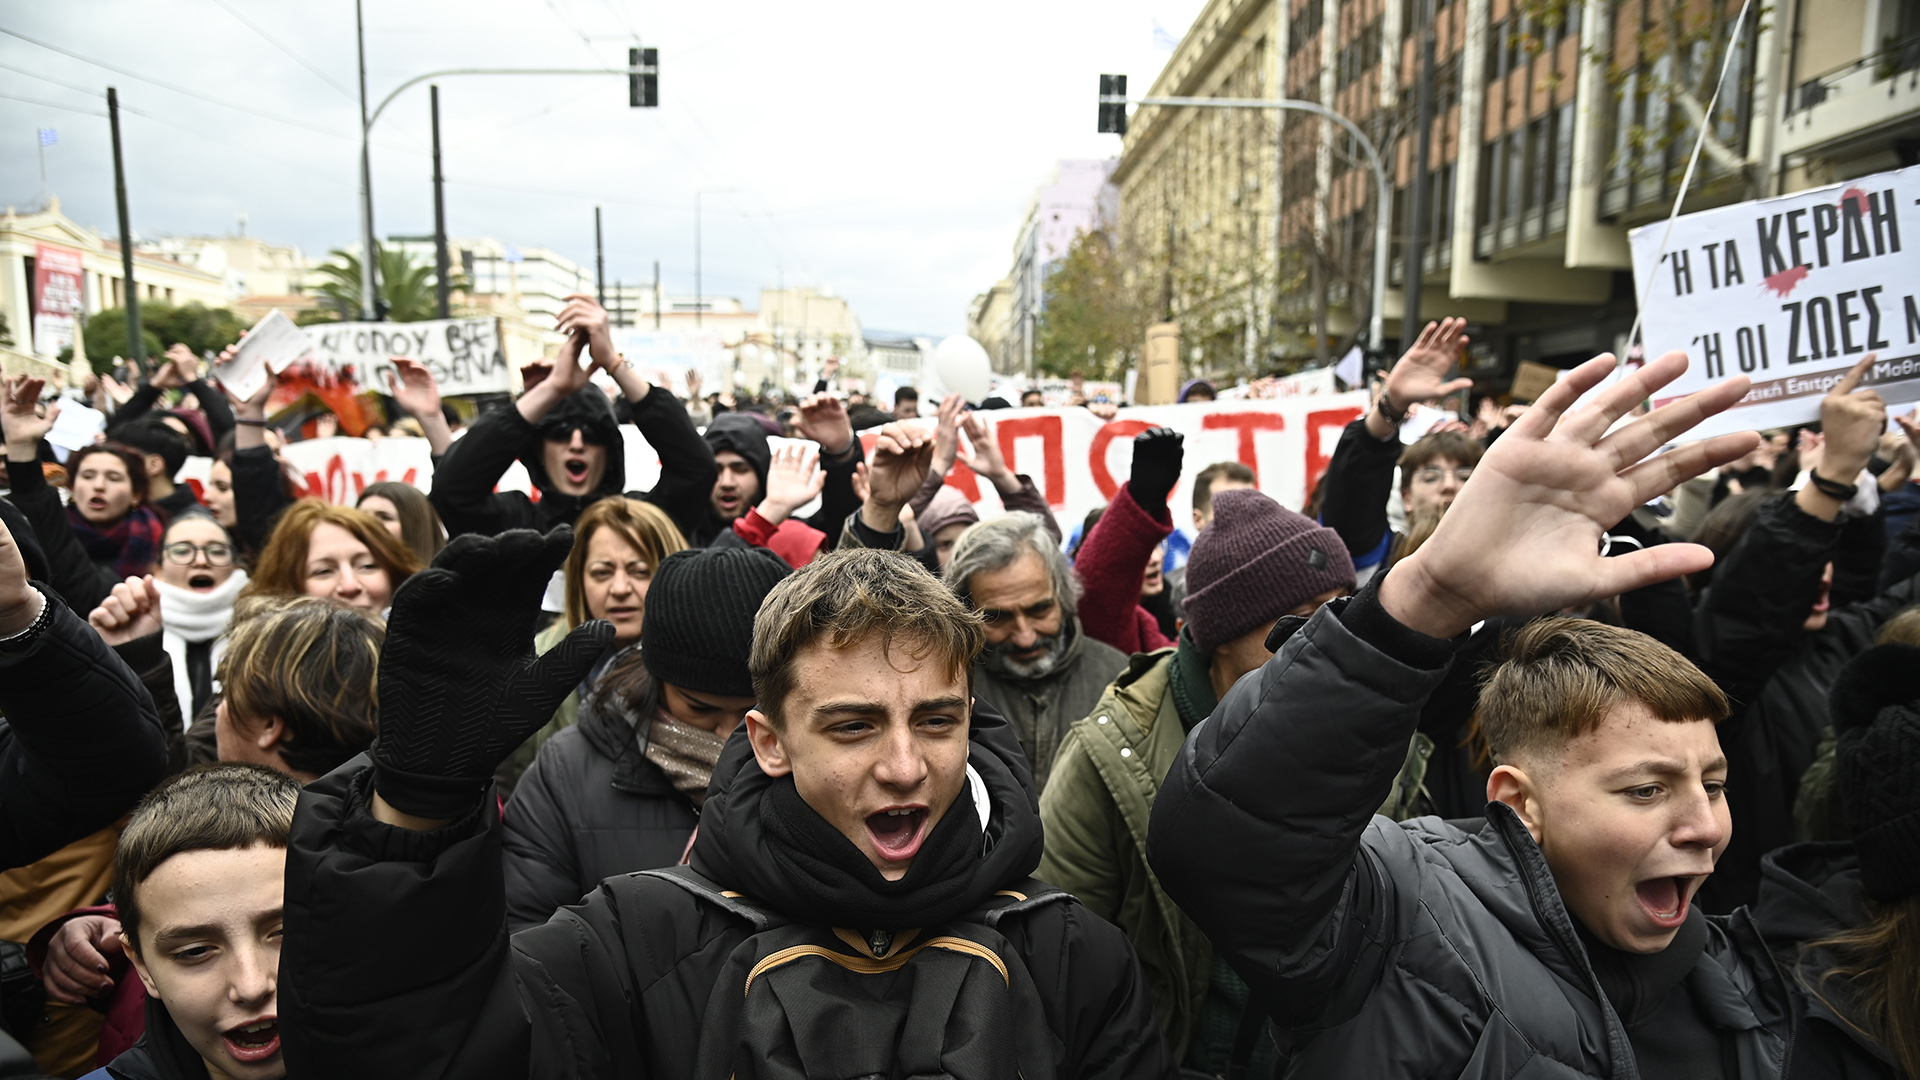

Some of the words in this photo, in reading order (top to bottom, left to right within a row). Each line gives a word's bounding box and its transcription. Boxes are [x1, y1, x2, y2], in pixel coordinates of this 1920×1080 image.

[1702, 238, 1745, 290] ΤΑ
[1756, 188, 1902, 279] ΚΕΡΔΗ
[1735, 323, 1770, 373] ΟΙ
[1782, 285, 1890, 365] ΖΩΕΣ
